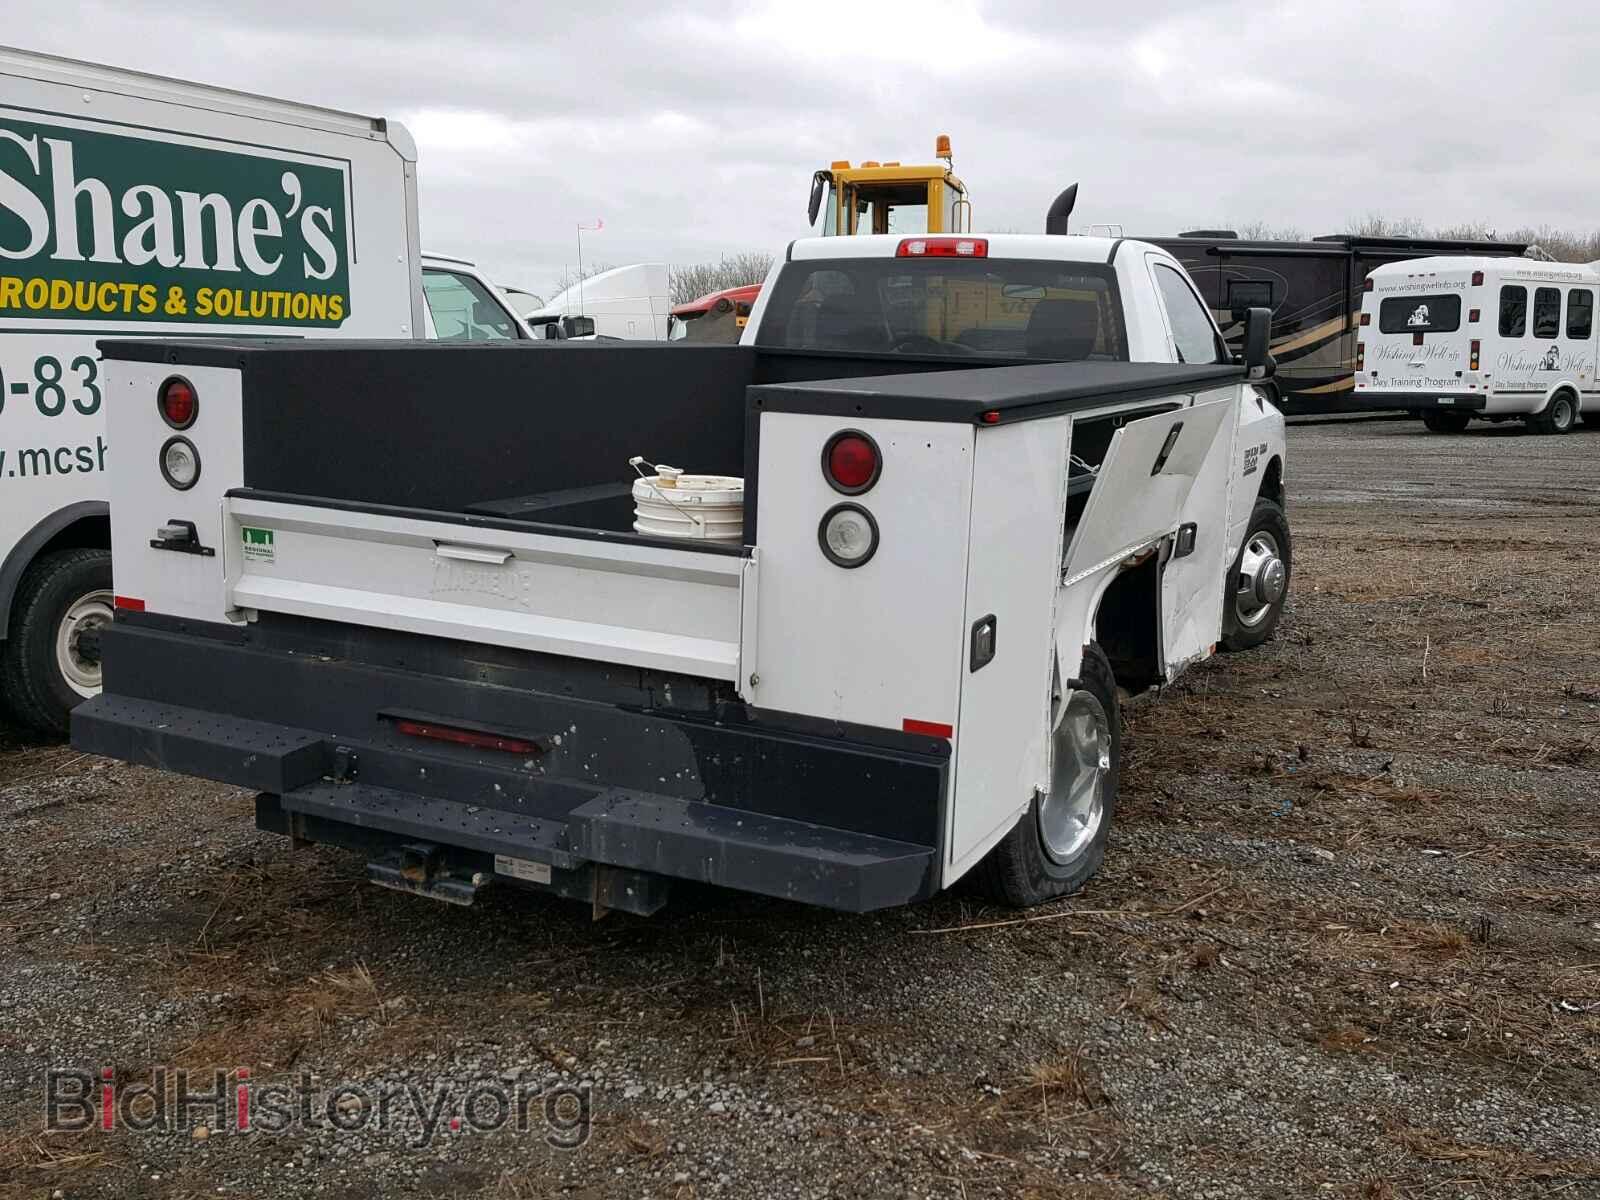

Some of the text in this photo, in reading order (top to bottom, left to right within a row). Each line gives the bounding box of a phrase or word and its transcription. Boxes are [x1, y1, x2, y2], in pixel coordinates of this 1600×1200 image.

[0, 128, 338, 281] Shane's
[164, 287, 187, 314] &
[195, 288, 344, 321] SOLUTIONS
[1374, 343, 1415, 361] Wishing
[1418, 342, 1448, 360] Well
[0, 355, 101, 417] -83
[1373, 377, 1460, 388] Day Training Program
